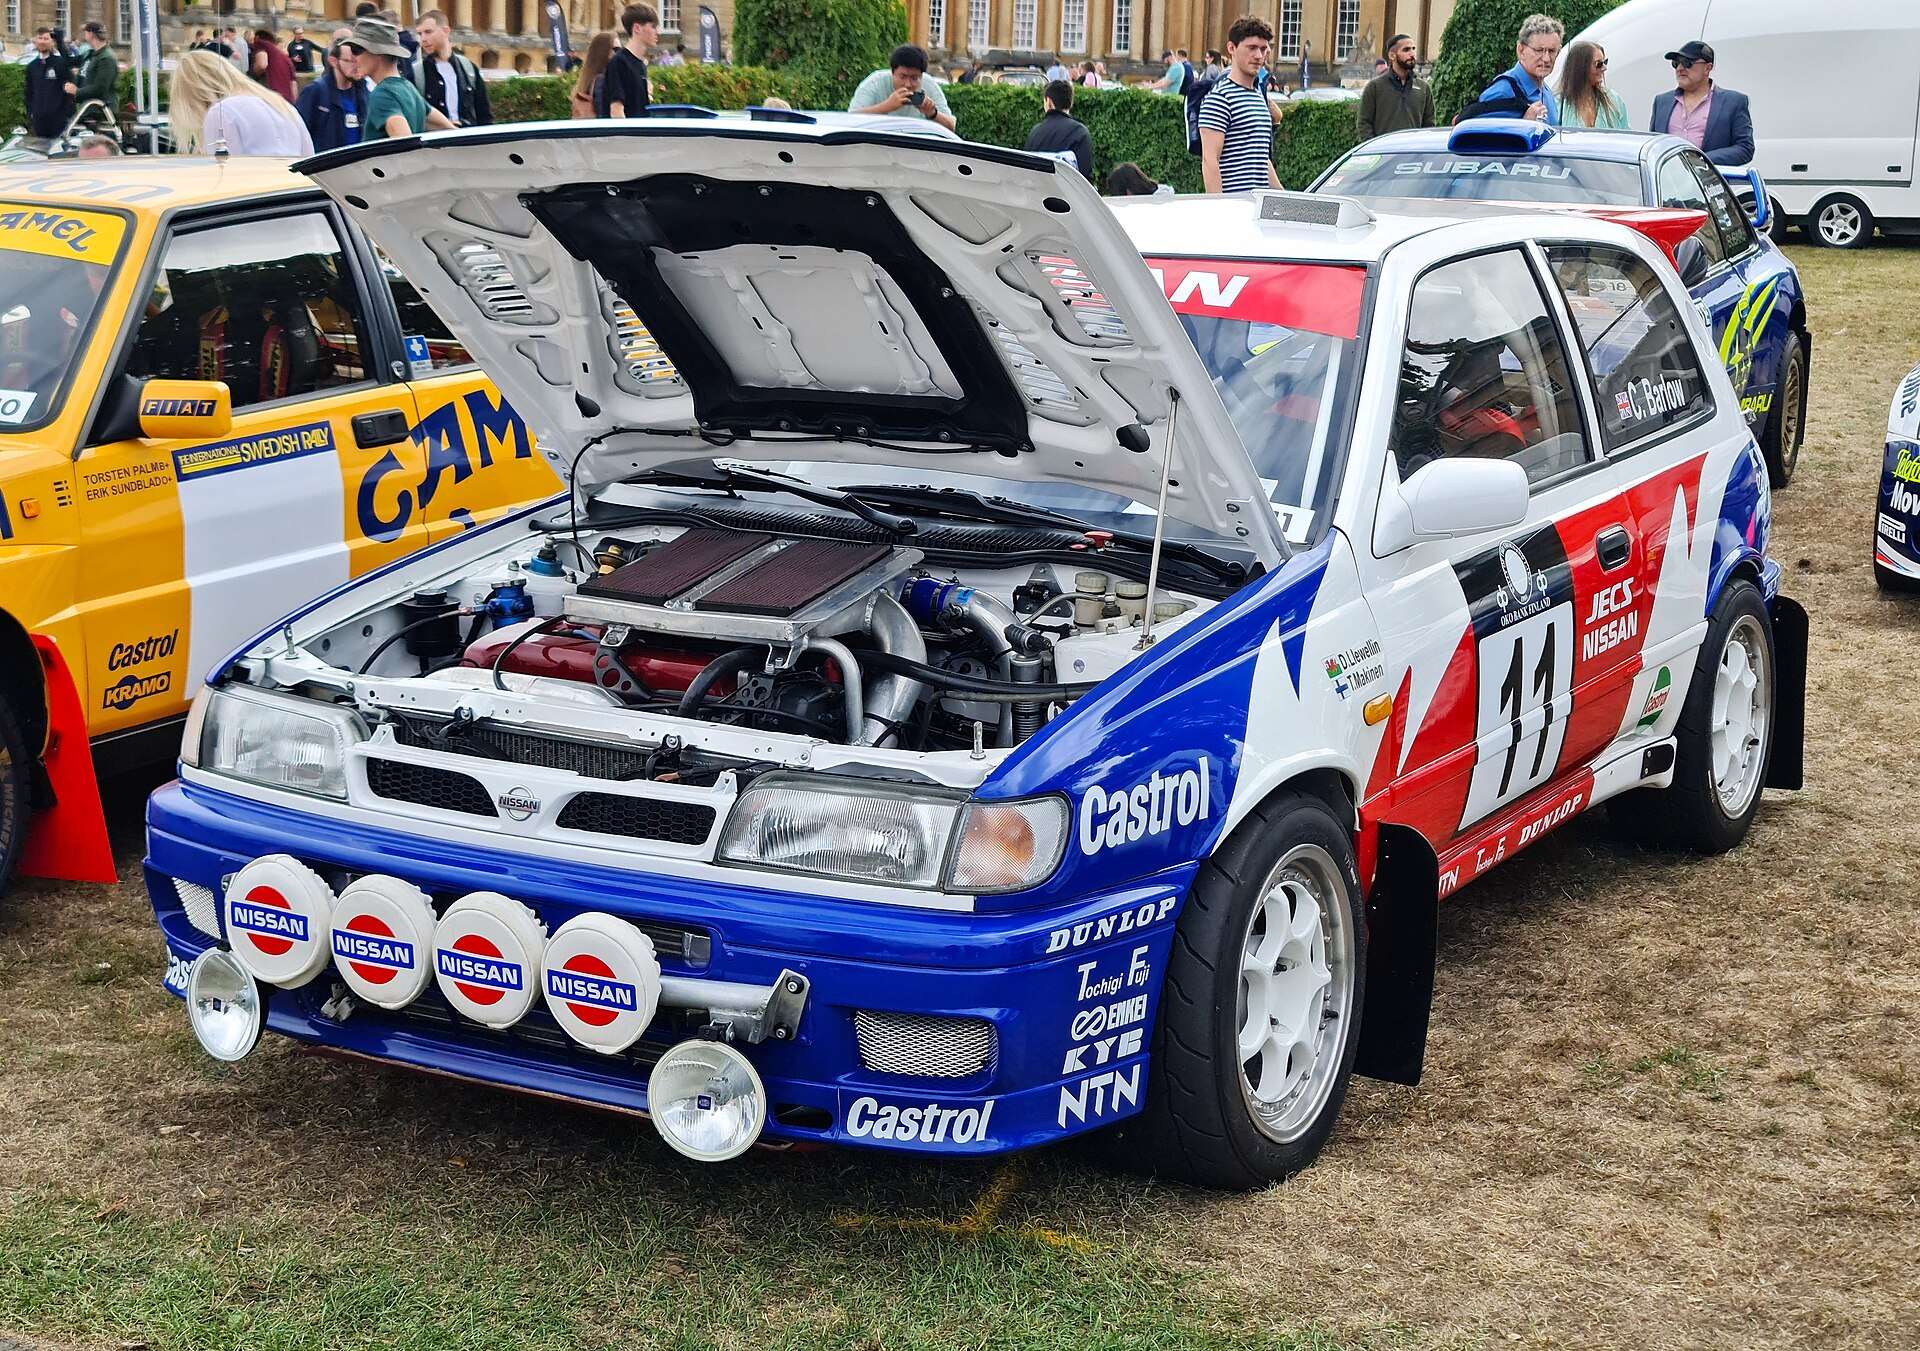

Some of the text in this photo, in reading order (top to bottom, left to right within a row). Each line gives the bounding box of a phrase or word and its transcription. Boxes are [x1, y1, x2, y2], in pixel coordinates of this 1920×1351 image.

[1393, 161, 1572, 179] SUBARU
[144, 401, 214, 415] FIAT
[1627, 374, 1686, 420] C. Barlow
[240, 434, 300, 462] SWEDISH
[302, 427, 329, 450] RALLY
[83, 467, 131, 485] TORSTEN
[86, 486, 110, 501] ERIK
[1878, 511, 1906, 544] PIRELLI
[1513, 605, 1529, 622] BANK
[1528, 596, 1551, 615] FINLAND
[1585, 576, 1635, 626] JECS
[108, 628, 179, 672] Castrol
[1582, 609, 1638, 662] NISSAN
[105, 674, 170, 706] KRAMO
[1497, 621, 1556, 799] 11
[499, 796, 538, 810] NISSAN
[1079, 756, 1211, 857] Castrol
[1517, 793, 1583, 846] DUNLOP
[234, 906, 304, 936] NISSAN
[1045, 896, 1176, 954] DUNLOP
[336, 935, 410, 964] NISSAN
[441, 954, 519, 985] NISSAN
[1077, 945, 1151, 1001] Tochigi Fuji
[552, 975, 632, 1006] NISSAN
[1106, 993, 1148, 1030] ENKEI
[1062, 1028, 1144, 1075] KYB
[1058, 1064, 1141, 1129] NTN
[846, 1097, 994, 1145] Castrol
